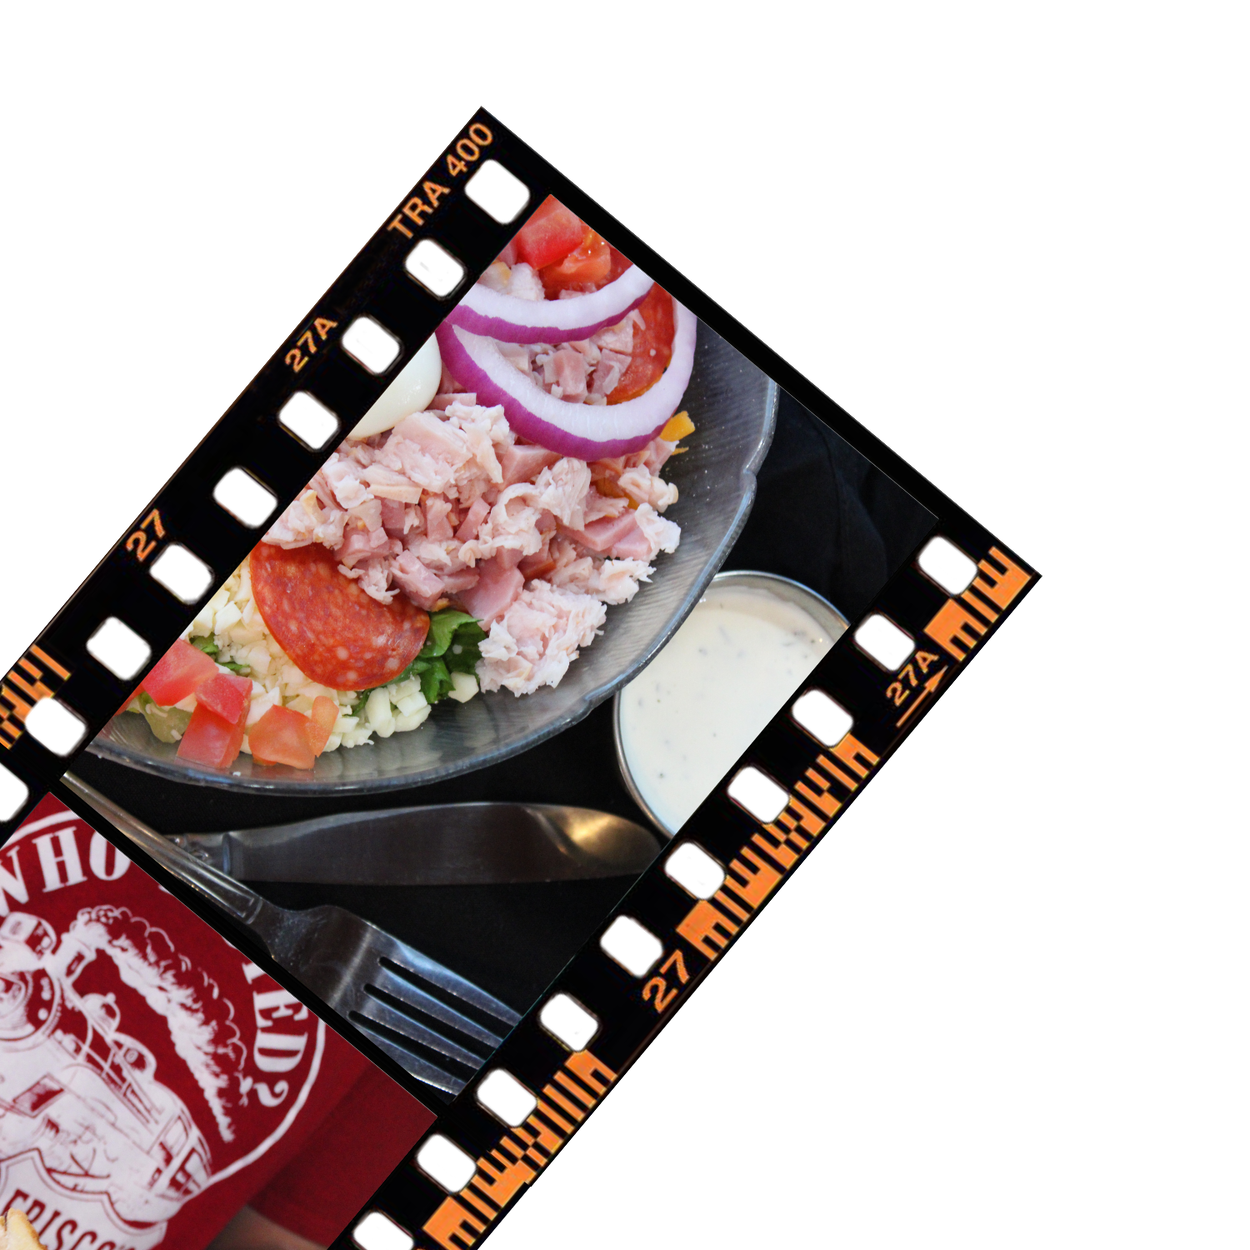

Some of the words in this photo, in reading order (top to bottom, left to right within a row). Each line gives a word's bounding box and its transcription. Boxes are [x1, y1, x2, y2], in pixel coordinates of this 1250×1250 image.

[386, 181, 451, 239] TRA
[445, 122, 494, 178] 400
[284, 316, 339, 374] 27A
[124, 508, 166, 562] 27
[885, 649, 940, 707] 27A
[642, 948, 691, 1014] 27
